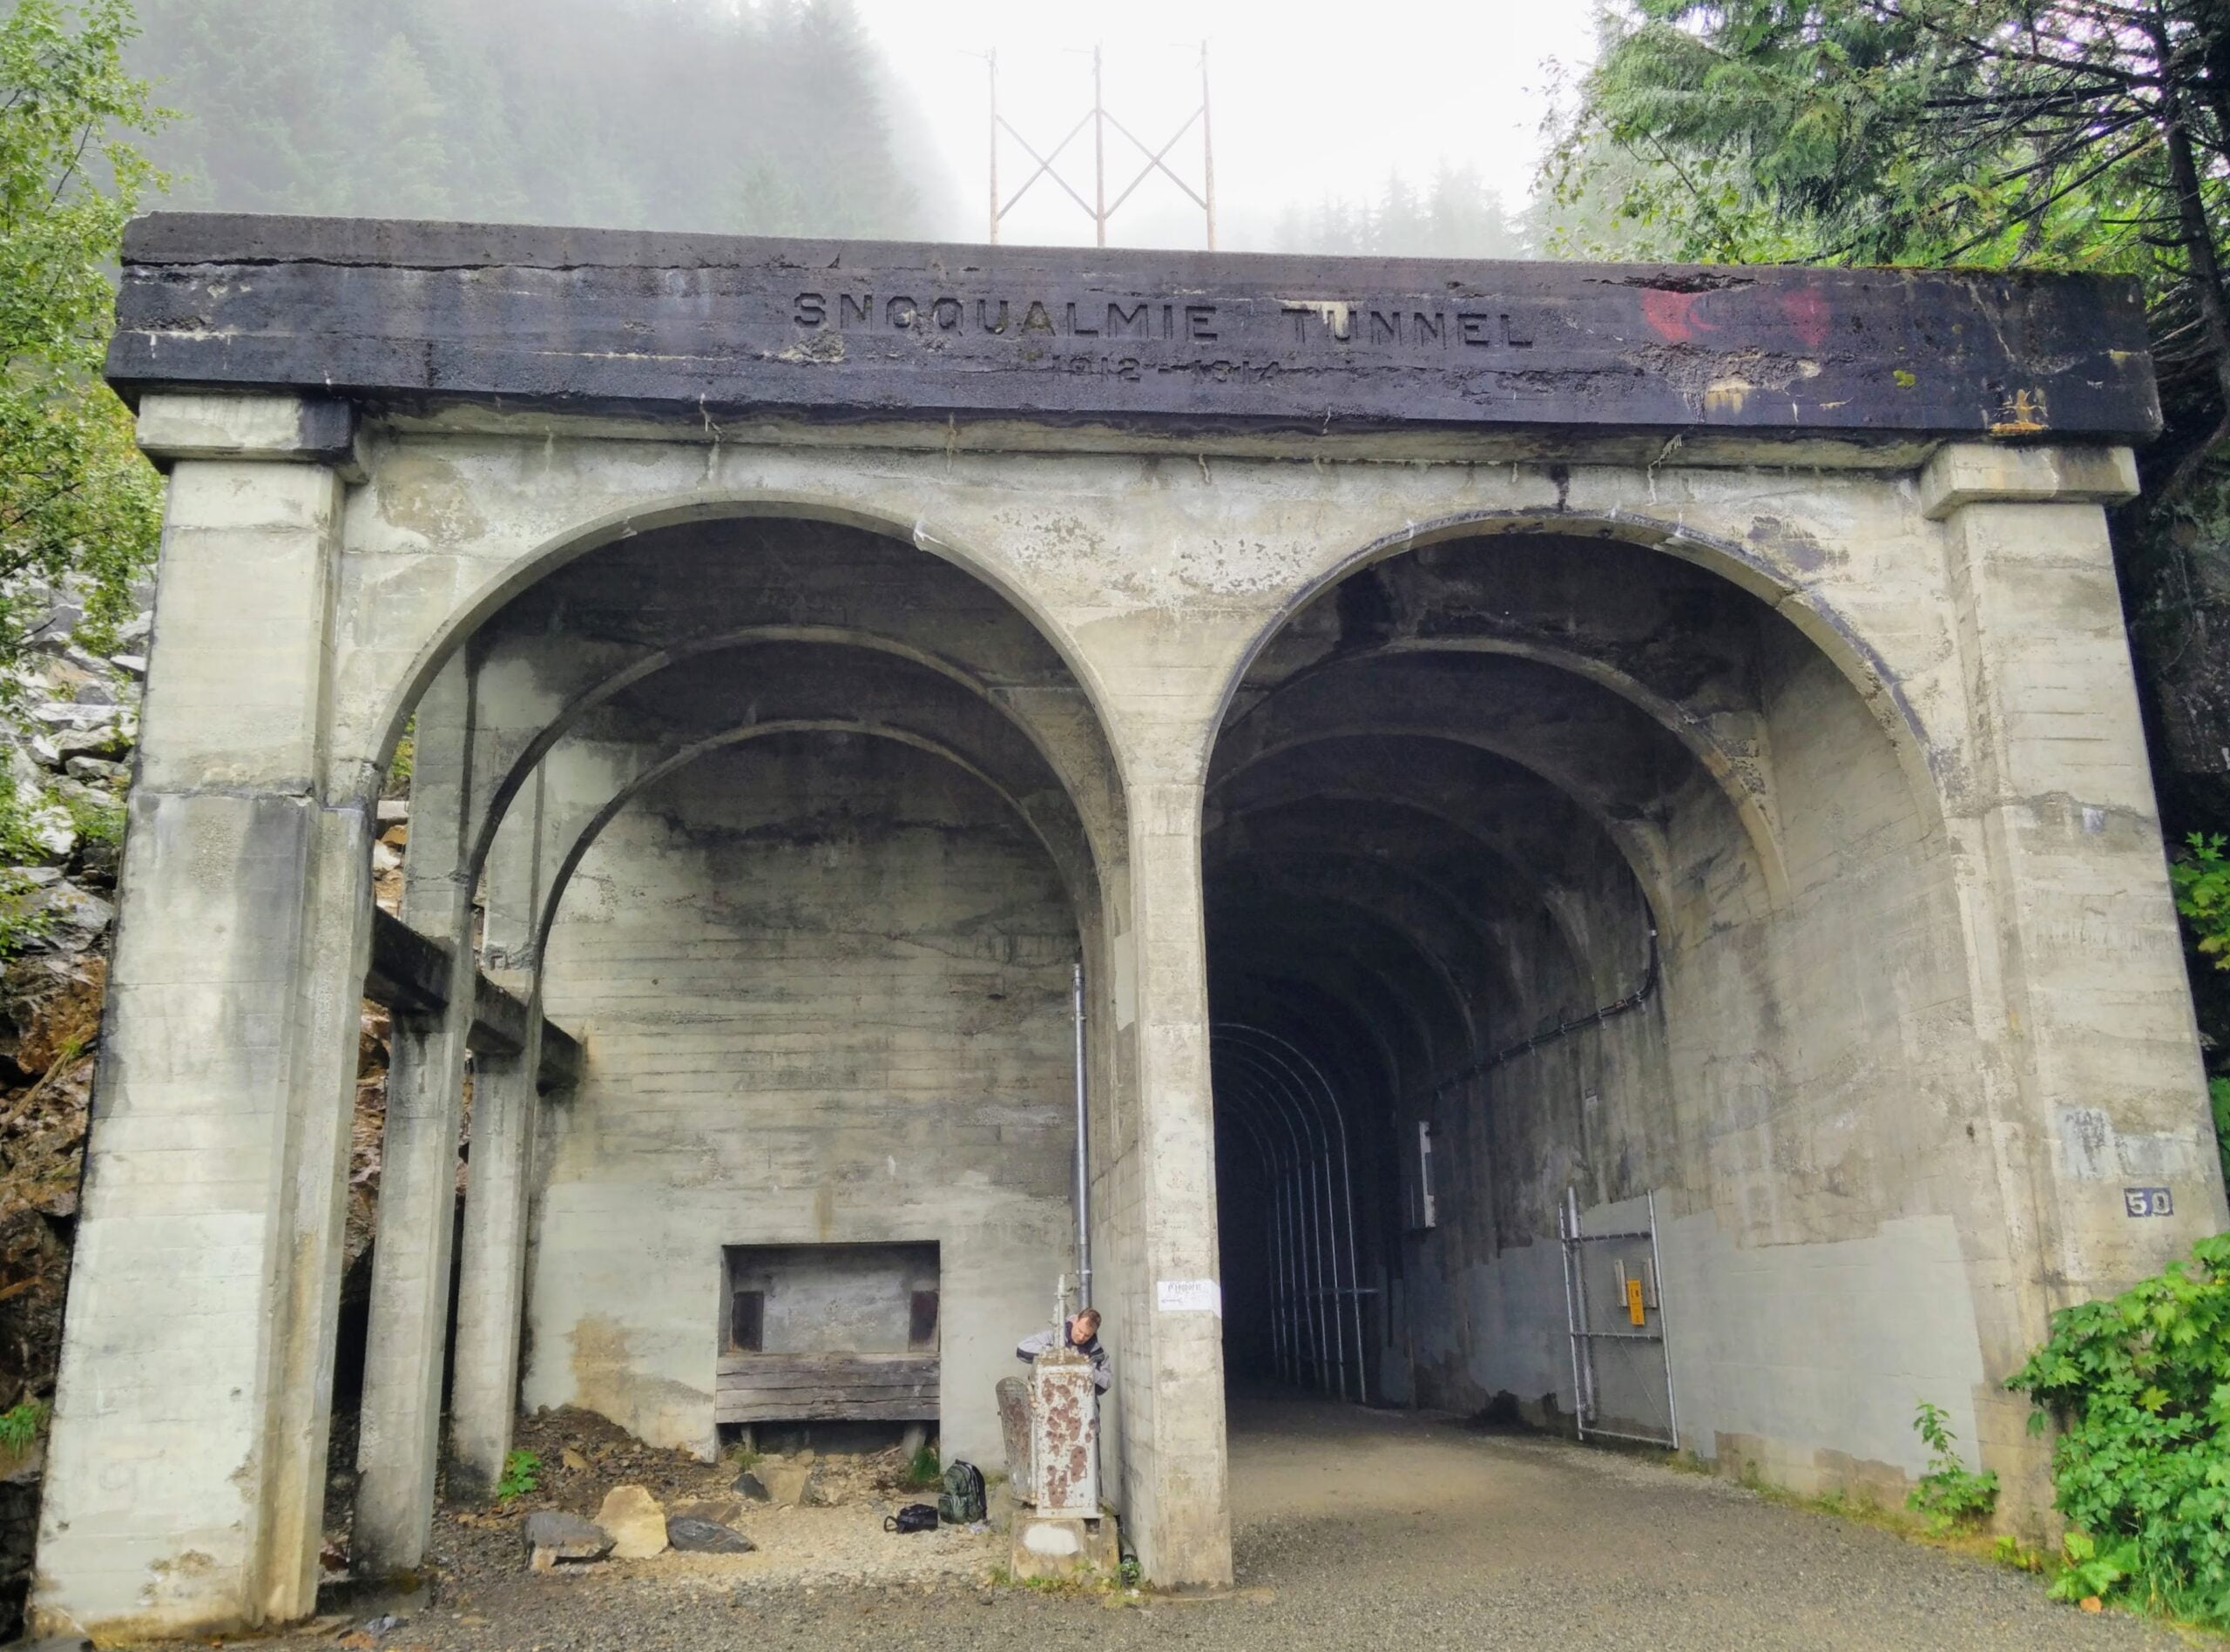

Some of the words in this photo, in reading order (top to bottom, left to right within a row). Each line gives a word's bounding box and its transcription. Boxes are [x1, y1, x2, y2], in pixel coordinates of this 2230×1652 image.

[794, 293, 1218, 341] SNOQUALMIE
[1281, 307, 1533, 348] TUNNEL
[2125, 1191, 2171, 1215] 50
